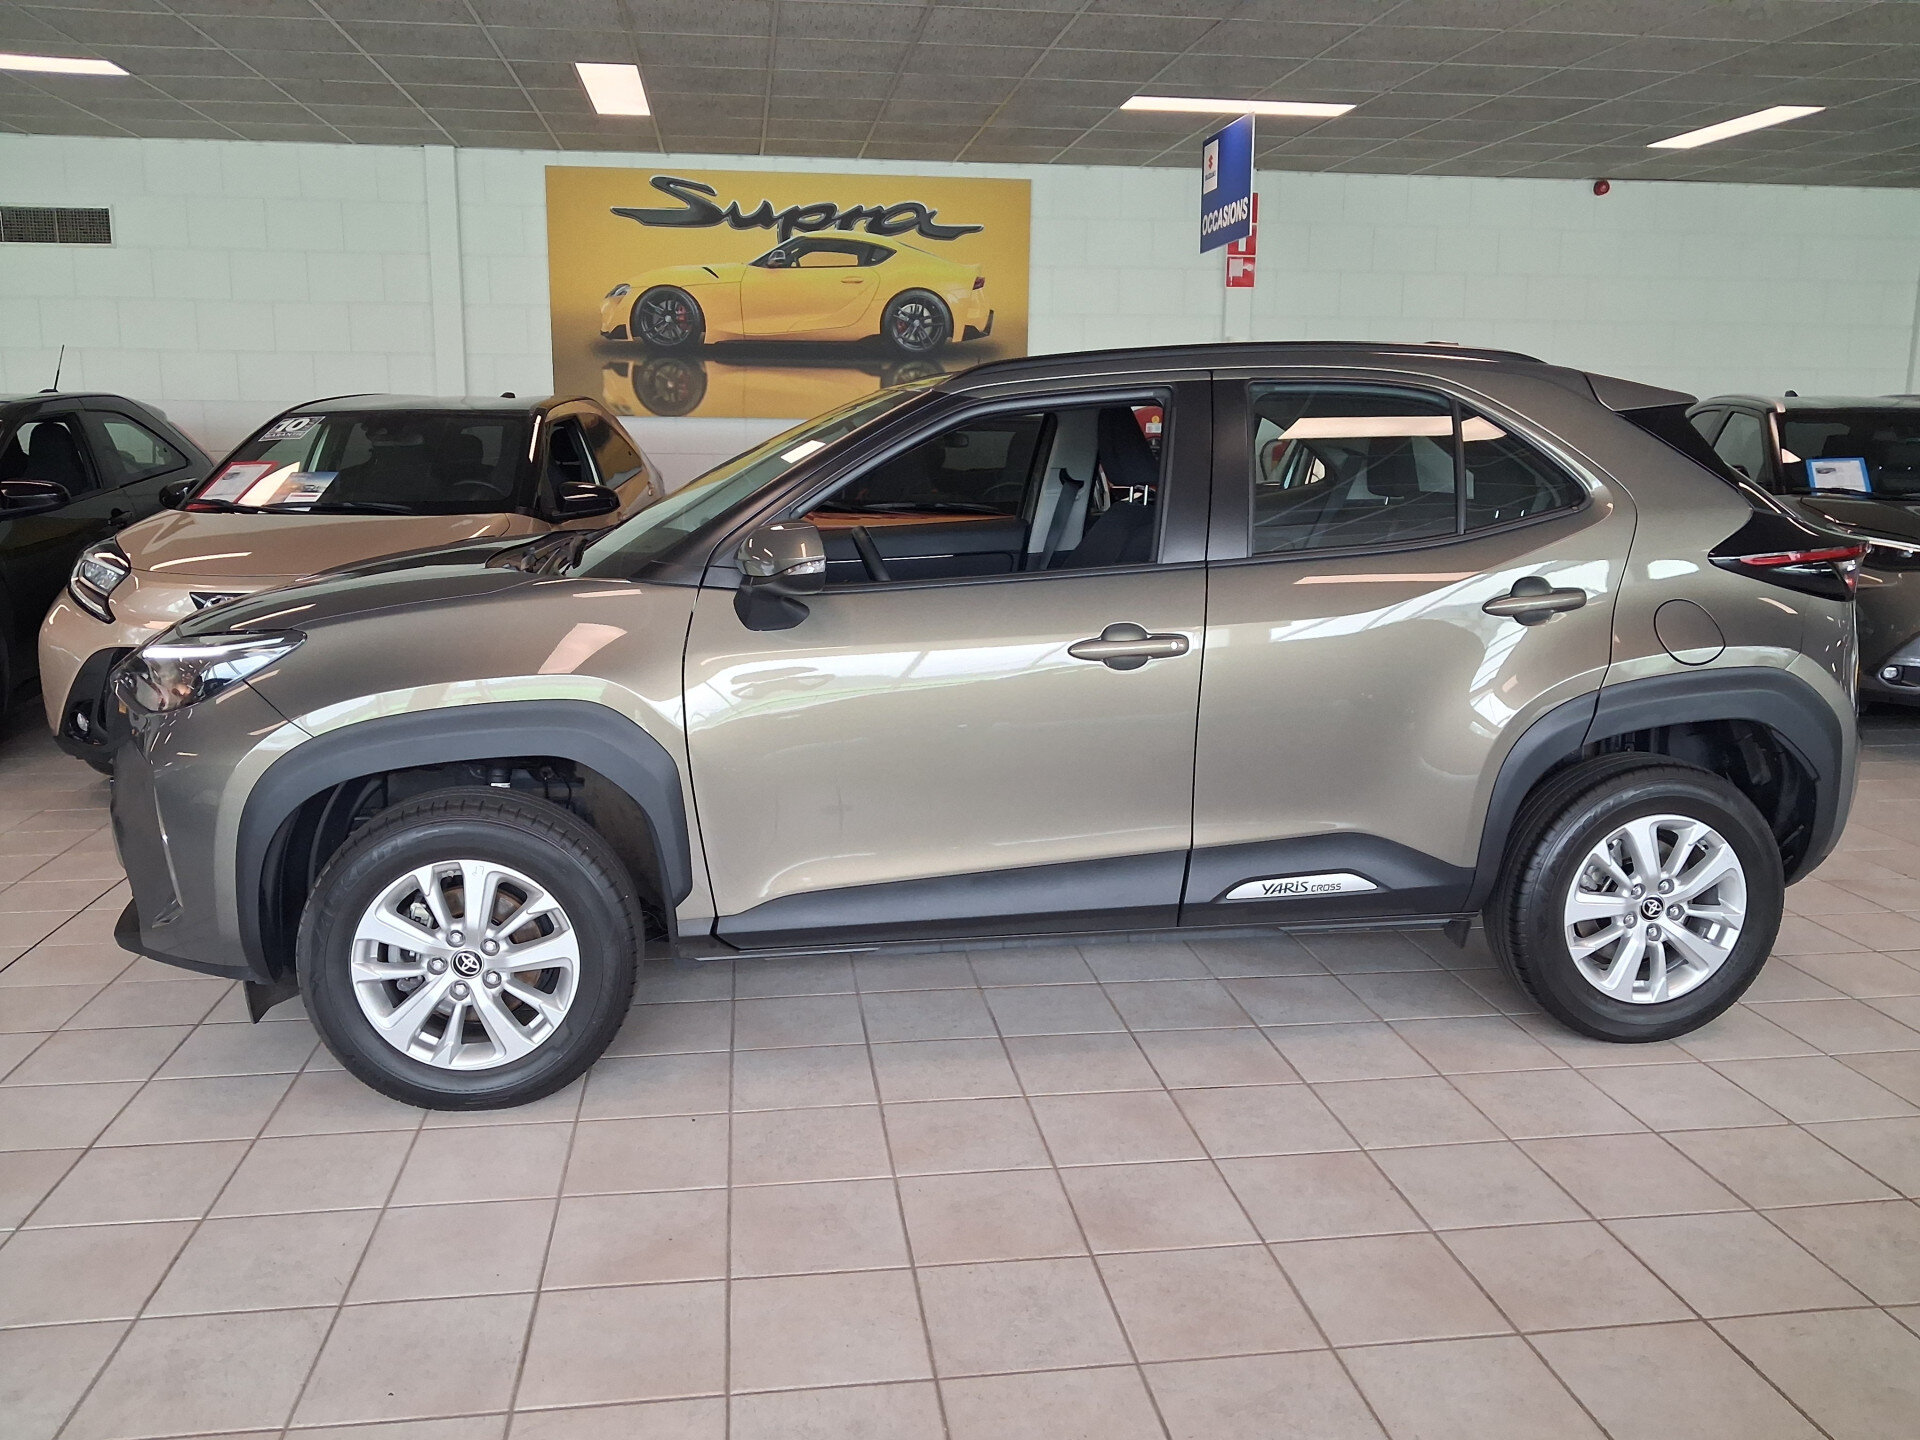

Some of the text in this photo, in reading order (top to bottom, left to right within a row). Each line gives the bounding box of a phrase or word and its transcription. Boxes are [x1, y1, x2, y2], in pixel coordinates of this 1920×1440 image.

[609, 174, 984, 244] Supra
[1202, 196, 1249, 236] OCCASIONS
[275, 418, 311, 432] 10
[1310, 882, 1342, 893] CROSS
